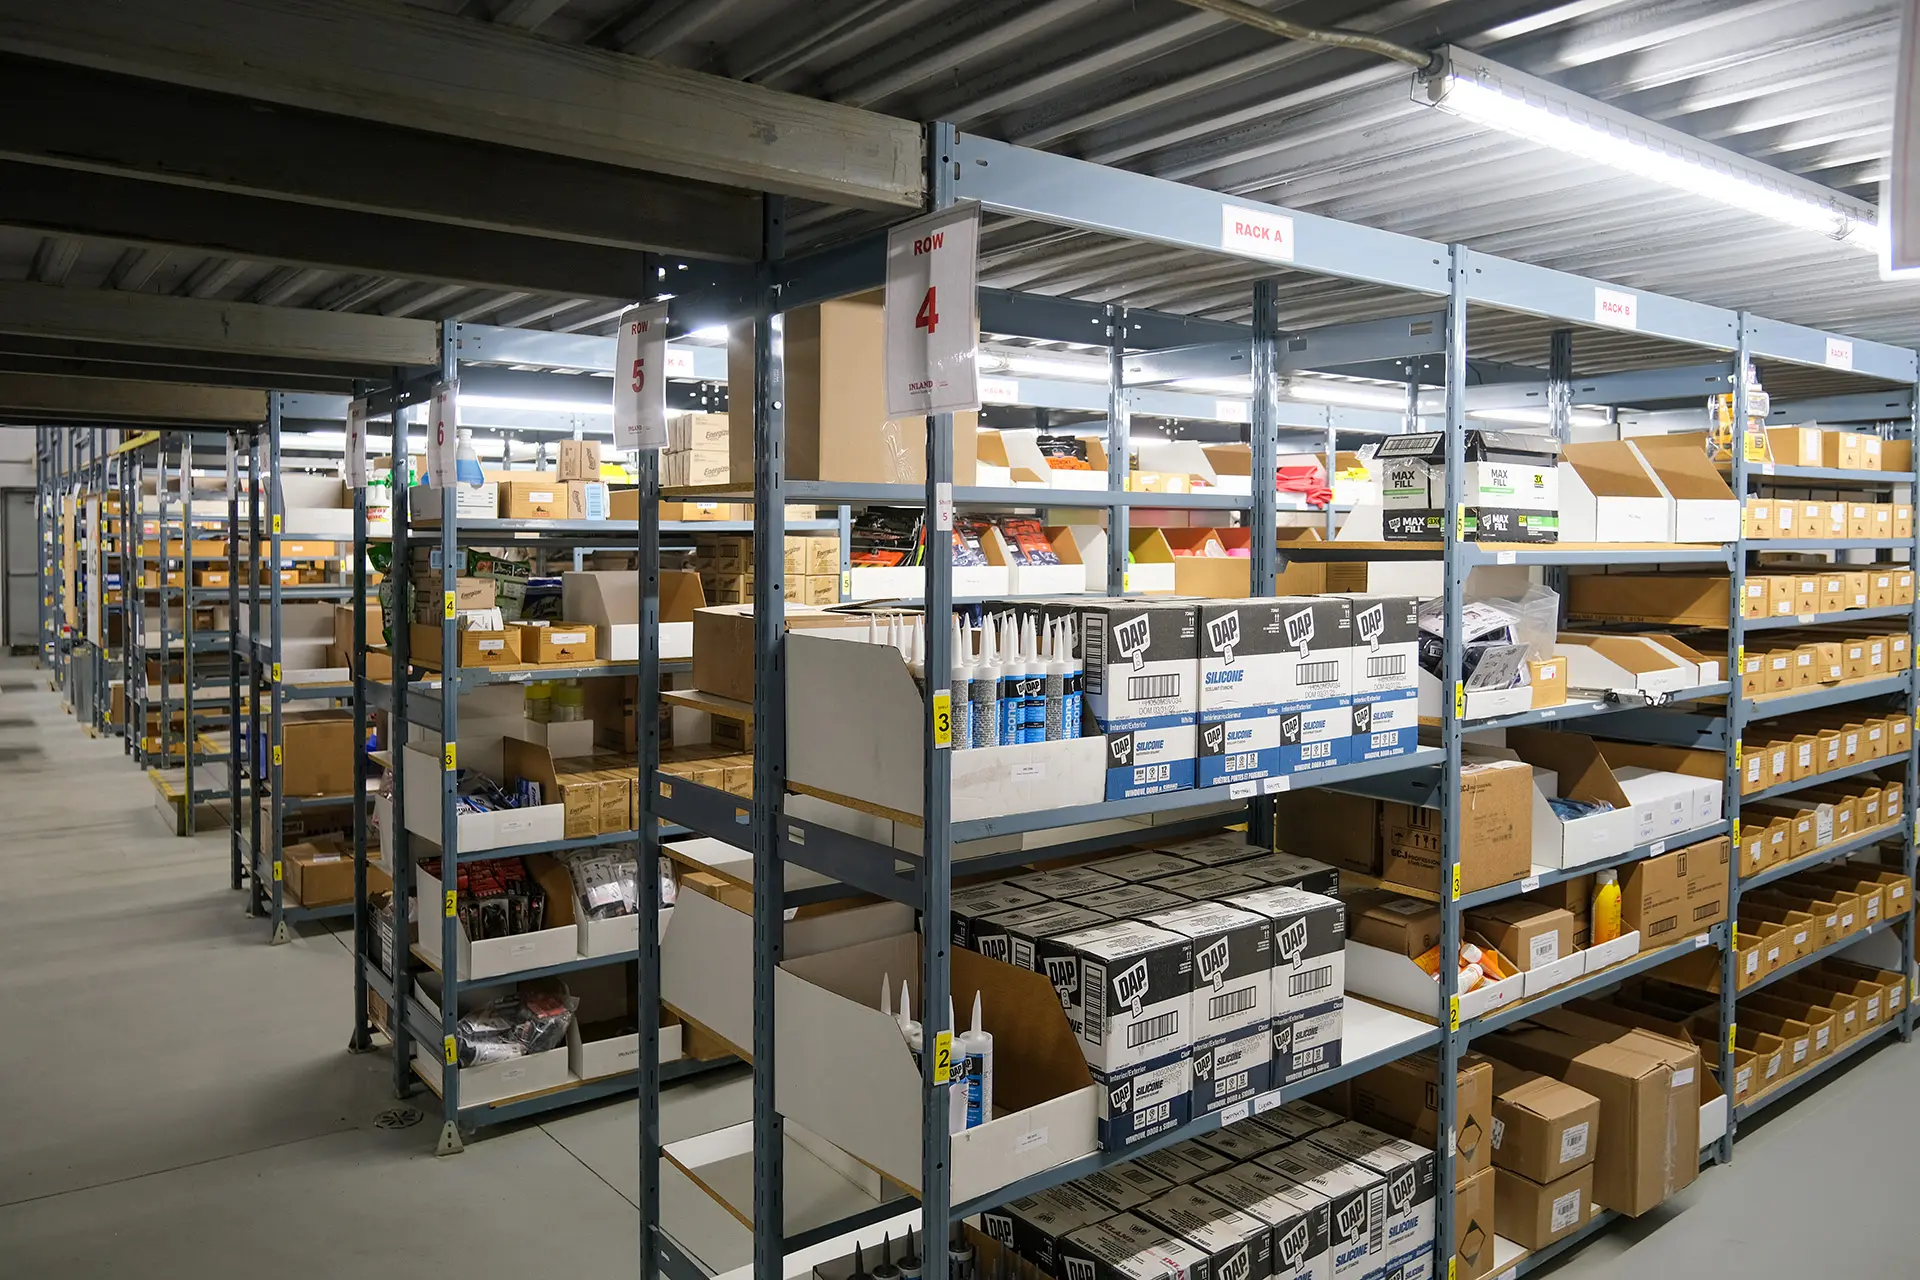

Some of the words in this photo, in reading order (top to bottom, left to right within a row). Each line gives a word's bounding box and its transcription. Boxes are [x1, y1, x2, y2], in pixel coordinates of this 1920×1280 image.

[1235, 222, 1270, 241] RACK
[1274, 230, 1283, 243] A
[913, 232, 944, 256] ROW
[915, 286, 939, 334] 4
[1602, 301, 1624, 315] RACK
[1624, 305, 1631, 316] B
[631, 320, 649, 336] ROW
[631, 358, 645, 393] 5
[908, 380, 934, 392] INLAND
[437, 421, 444, 446] 6
[352, 432, 358, 453] 7
[1392, 471, 1415, 480] MAX
[1491, 468, 1508, 478] MAX
[1534, 474, 1543, 484] 3X
[1394, 480, 1412, 488] FILL
[1493, 478, 1506, 486] FILL
[942, 512, 948, 521] 5
[1402, 517, 1425, 526] MAX
[1428, 516, 1439, 525] 3X
[1492, 514, 1509, 524] MAX
[1457, 518, 1462, 532] 5
[1494, 523, 1508, 531] FILL
[844, 580, 850, 588] 5
[460, 589, 482, 599] Energizer
[446, 601, 454, 610] 4
[1288, 612, 1312, 642] DAP
[1360, 608, 1382, 637] DAP
[1118, 619, 1148, 653] DAP
[1212, 616, 1238, 648] DAP
[1205, 670, 1244, 684] SILICONE
[1026, 680, 1040, 692] DAP
[1354, 695, 1382, 704] Interior/Exterior
[1457, 696, 1462, 709] 4
[1267, 707, 1278, 715] Blanc
[1282, 704, 1312, 712] Interior/Exterior
[1356, 708, 1368, 724] DAP
[1372, 710, 1394, 720] SILICONE
[938, 713, 950, 732] 3
[1110, 721, 1147, 731] Interior/Exterior
[1284, 718, 1298, 735] DAP
[1302, 720, 1326, 731] SILICONE
[1206, 728, 1222, 744] DAP
[1226, 730, 1252, 740] SILICONE
[1114, 738, 1130, 756] DAP
[1136, 740, 1164, 752] SILICONE
[446, 754, 452, 766] 3
[1162, 766, 1168, 774] 12
[1734, 830, 1740, 840] 3
[1390, 848, 1408, 859] SCJ
[1454, 878, 1460, 892] 3
[446, 898, 453, 908] 2
[1280, 922, 1306, 956] DAP
[982, 939, 1006, 958] DAP
[1200, 942, 1226, 977] DAP
[1050, 960, 1075, 986] DAP
[1118, 964, 1146, 1002] DAP
[1272, 1013, 1304, 1026] Interior/Exterior
[1450, 1010, 1456, 1022] 2
[1194, 1037, 1226, 1052] Interior/Exterior
[1258, 1022, 1270, 1032] Clear
[1276, 1030, 1290, 1046] DAP
[1295, 1026, 1318, 1040] SILICONE
[445, 1047, 451, 1058] 1
[938, 1049, 950, 1068] 2
[1216, 1050, 1242, 1067] SILICONE
[950, 1063, 962, 1078] DAP
[1110, 1066, 1146, 1082] Interior/Exterior
[1180, 1050, 1192, 1058] Clear
[1196, 1055, 1210, 1073] DAP
[1114, 1085, 1130, 1105] DAP
[1136, 1080, 1164, 1097] SILICONE
[1125, 1130, 1146, 1145] WINDOW,
[1146, 1126, 1158, 1137] DOOR
[1392, 1174, 1414, 1205] DAP
[1341, 1200, 1364, 1233] DAP
[988, 1216, 1012, 1244] DAP
[1388, 1216, 1419, 1238] SILICONE
[1284, 1224, 1307, 1260] DAP
[1336, 1242, 1368, 1267] SILICONE
[1068, 1260, 1094, 1280] DAP
[1223, 1250, 1248, 1280] DAP
[1405, 1264, 1425, 1280] SILICONE
